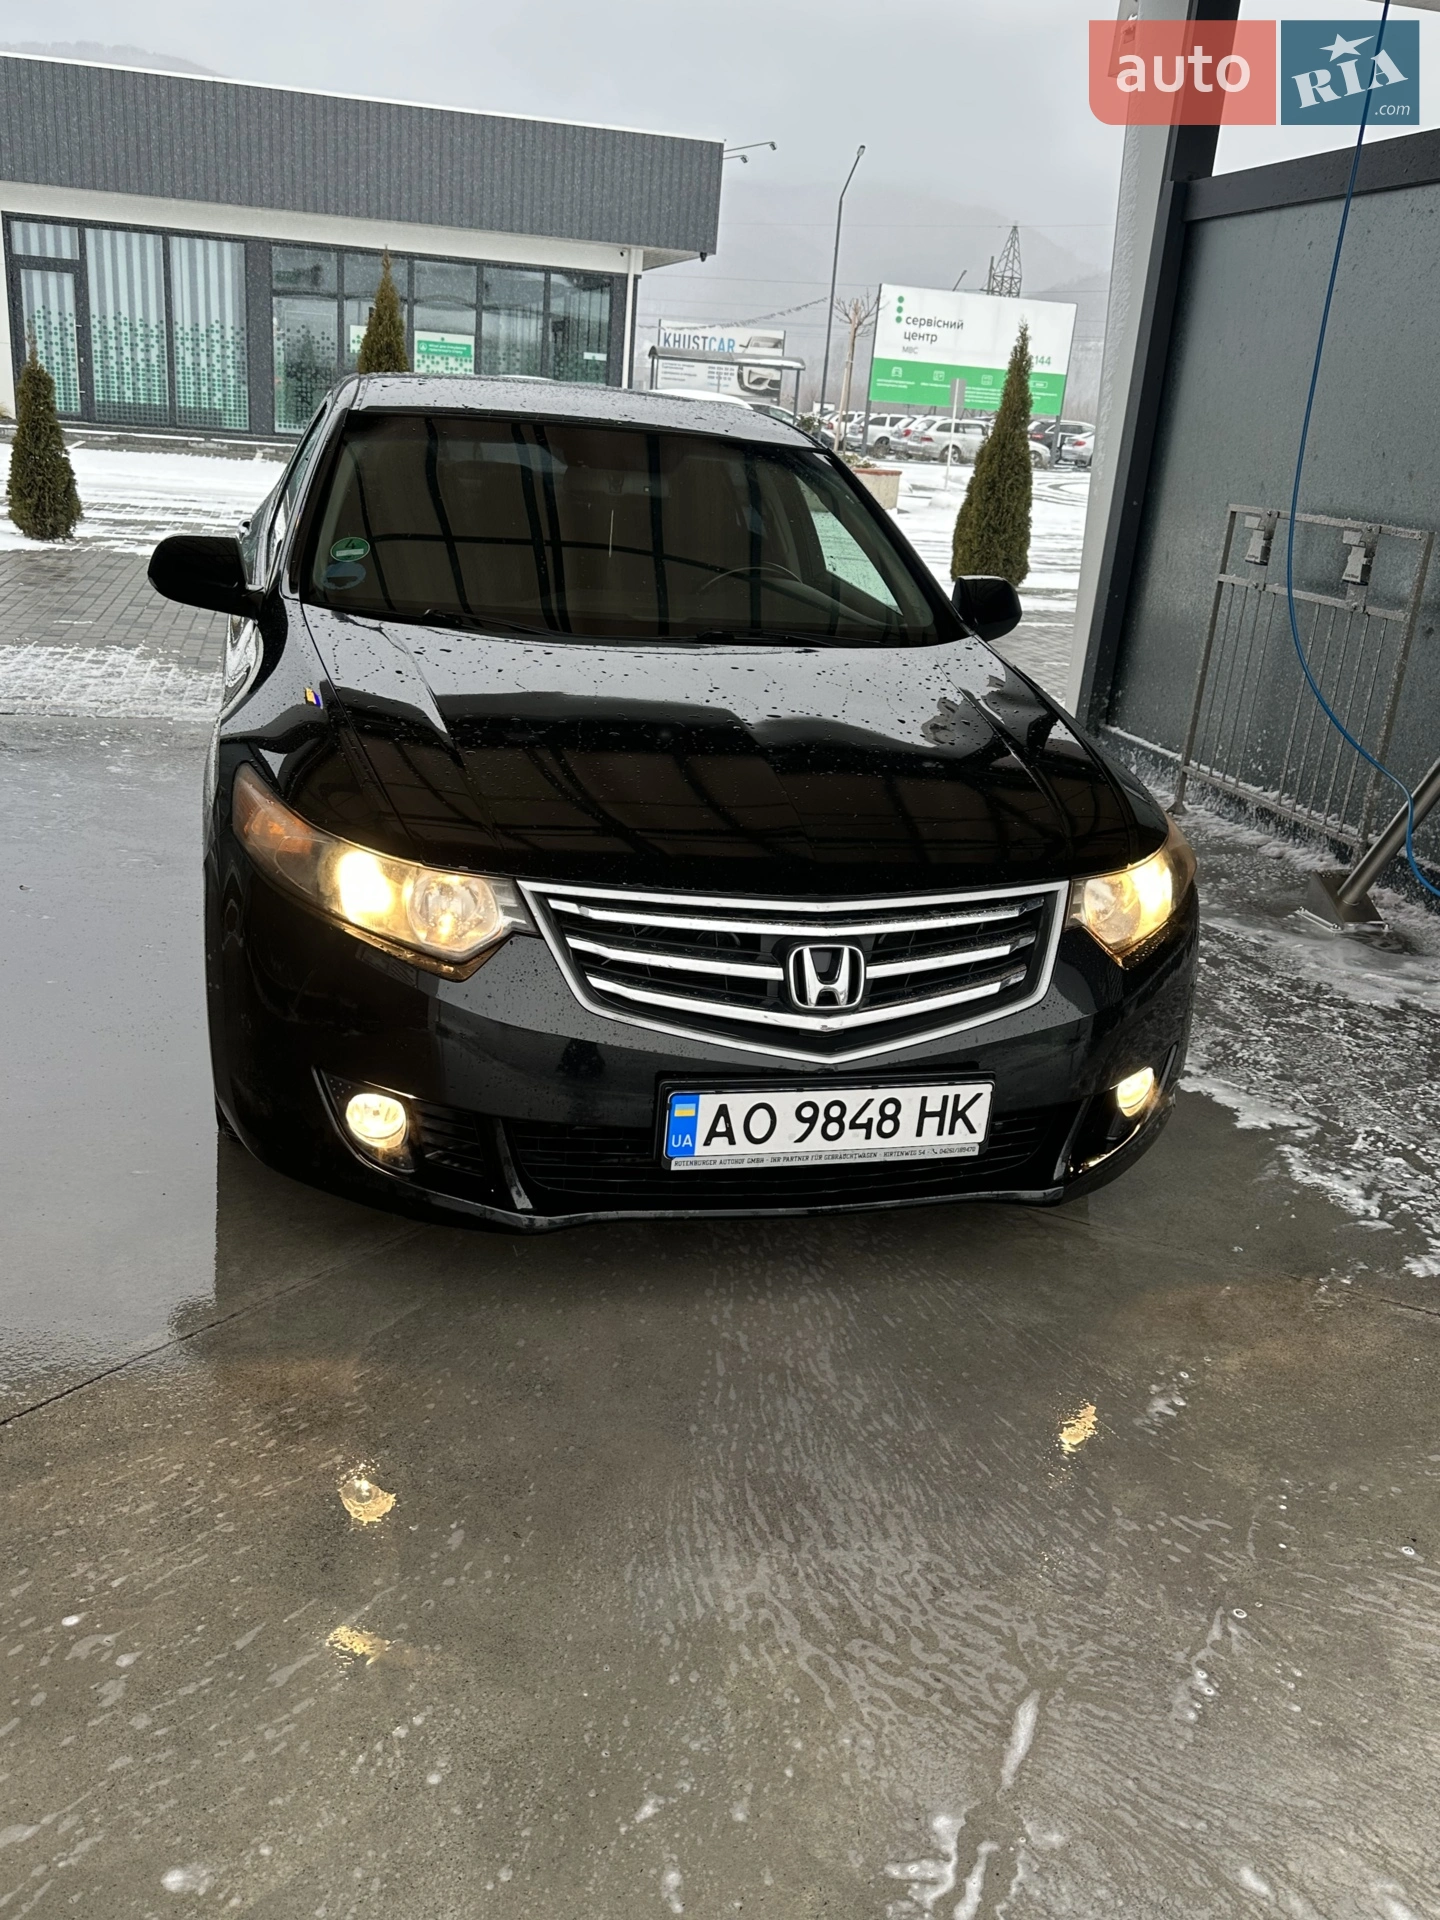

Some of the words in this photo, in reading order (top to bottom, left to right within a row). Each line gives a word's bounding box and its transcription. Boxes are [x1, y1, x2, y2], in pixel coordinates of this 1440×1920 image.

[905, 316, 964, 330] сервісний
[663, 332, 736, 353] KHUSTCAR
[903, 331, 938, 345] центр
[902, 346, 919, 355] МВС
[703, 1102, 777, 1147] AO
[794, 1097, 902, 1143] 9848
[915, 1092, 984, 1137] HK
[671, 1134, 693, 1148] UA
[674, 1159, 717, 1167] ROTENBURGER
[782, 1155, 809, 1163] PARTNER
